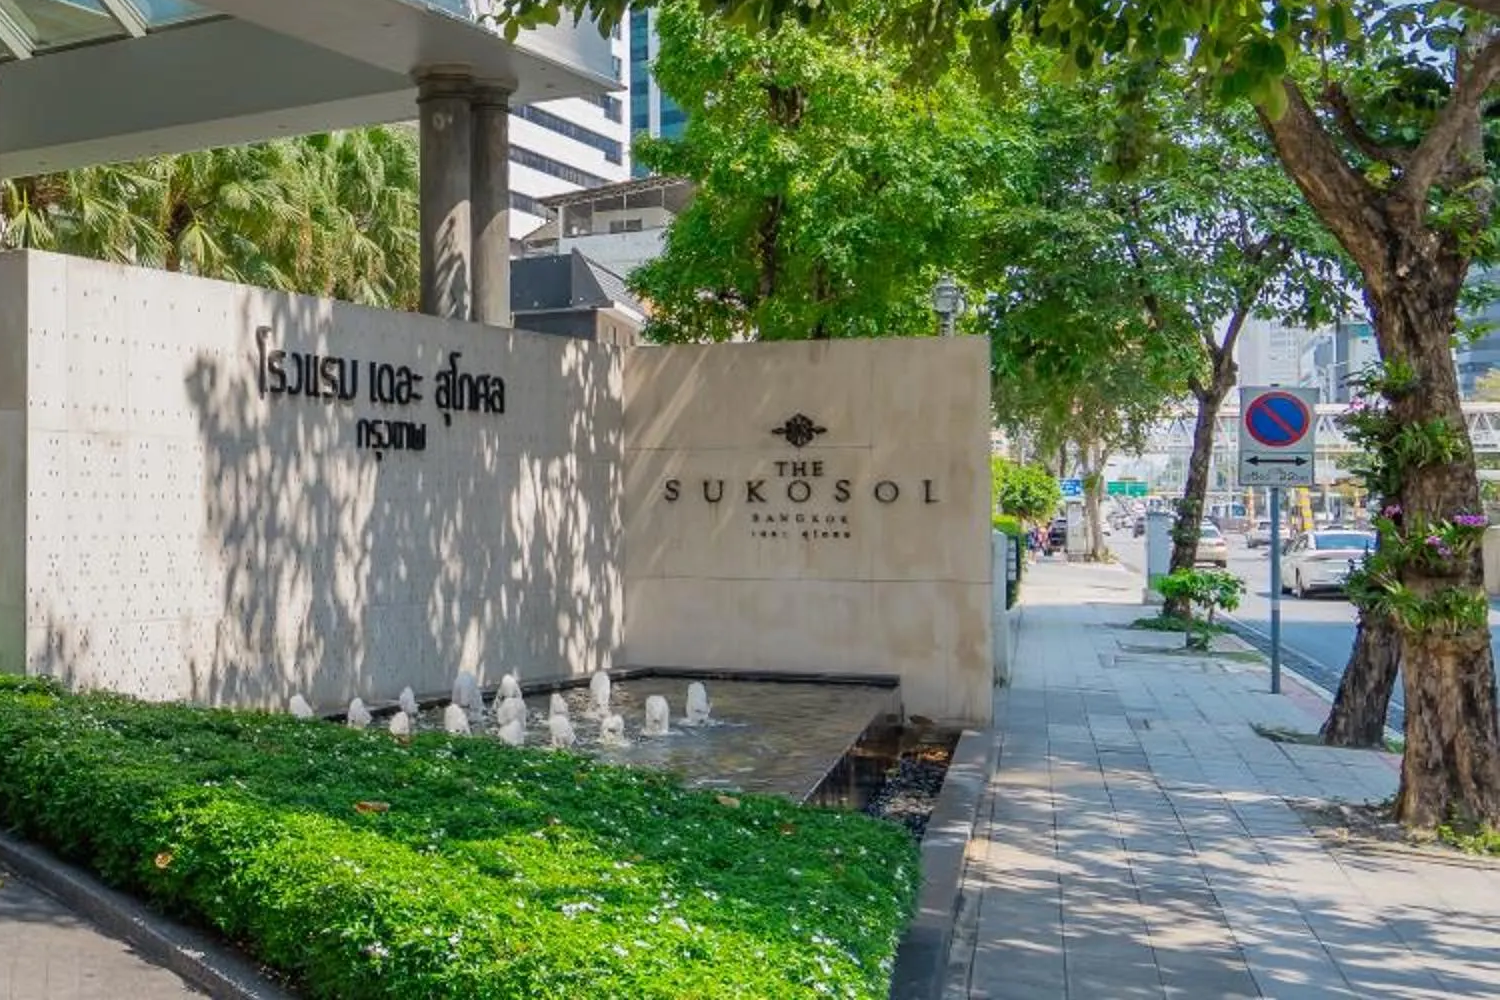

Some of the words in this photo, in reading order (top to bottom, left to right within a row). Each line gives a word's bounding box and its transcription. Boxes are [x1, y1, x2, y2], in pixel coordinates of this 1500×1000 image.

[255, 325, 359, 401] โรงแรม
[369, 360, 424, 405] เดอะ
[435, 351, 506, 427] สุโกศล
[357, 418, 427, 461] กรุงเทพ
[773, 460, 825, 478] THE
[663, 479, 942, 505] SUKOSOL
